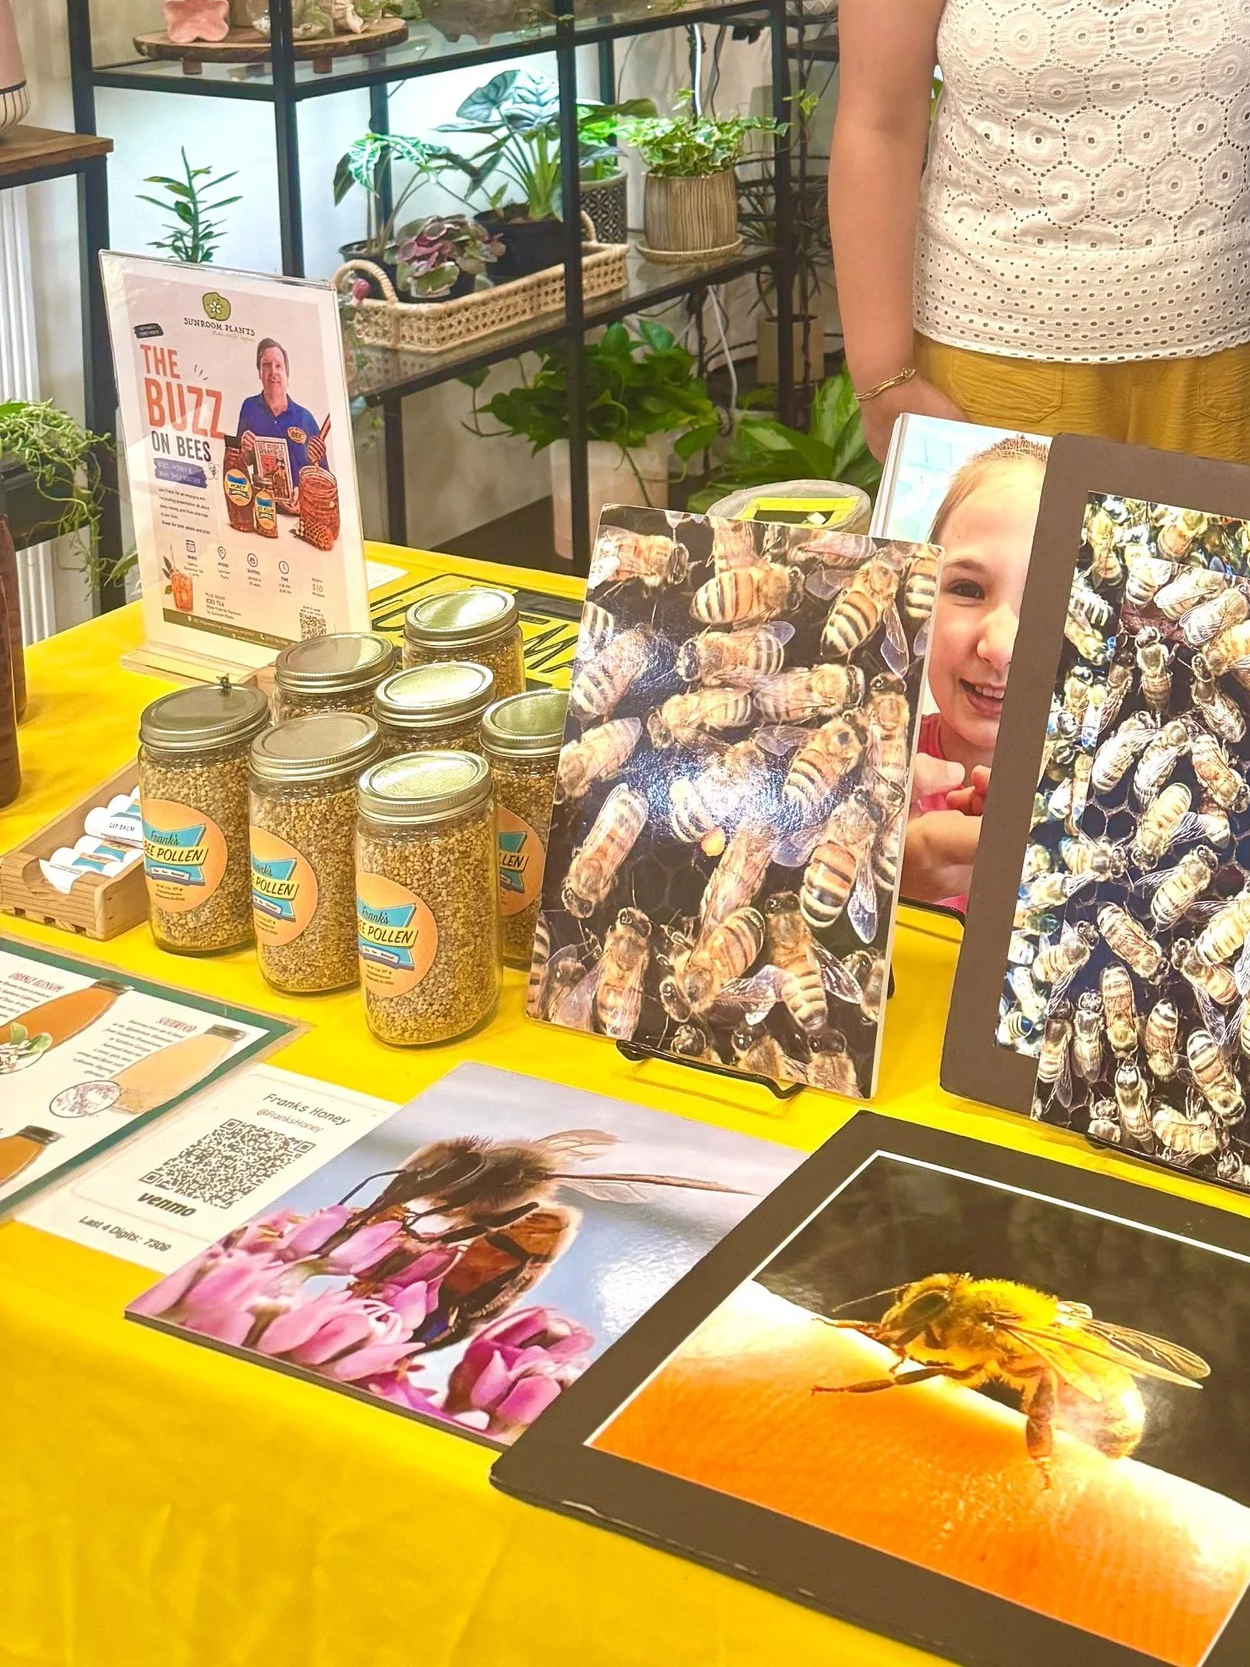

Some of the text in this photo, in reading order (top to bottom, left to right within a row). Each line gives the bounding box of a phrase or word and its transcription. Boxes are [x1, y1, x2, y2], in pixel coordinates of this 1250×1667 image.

[183, 318, 256, 336] SUNROOM PLANTS
[139, 343, 181, 379] THE
[144, 377, 225, 439] BUZZ
[151, 430, 212, 463] ON BEES
[151, 830, 180, 846] Frank's
[157, 847, 203, 862] POLLEN
[256, 876, 295, 896] POLLEN
[368, 925, 414, 944] POLLEN
[256, 1108, 324, 1134] @FranksHoney
[262, 1093, 351, 1126] Franks Honey
[137, 1192, 197, 1217] venmo
[78, 1215, 105, 1229] Last
[108, 1225, 143, 1243] Digits:
